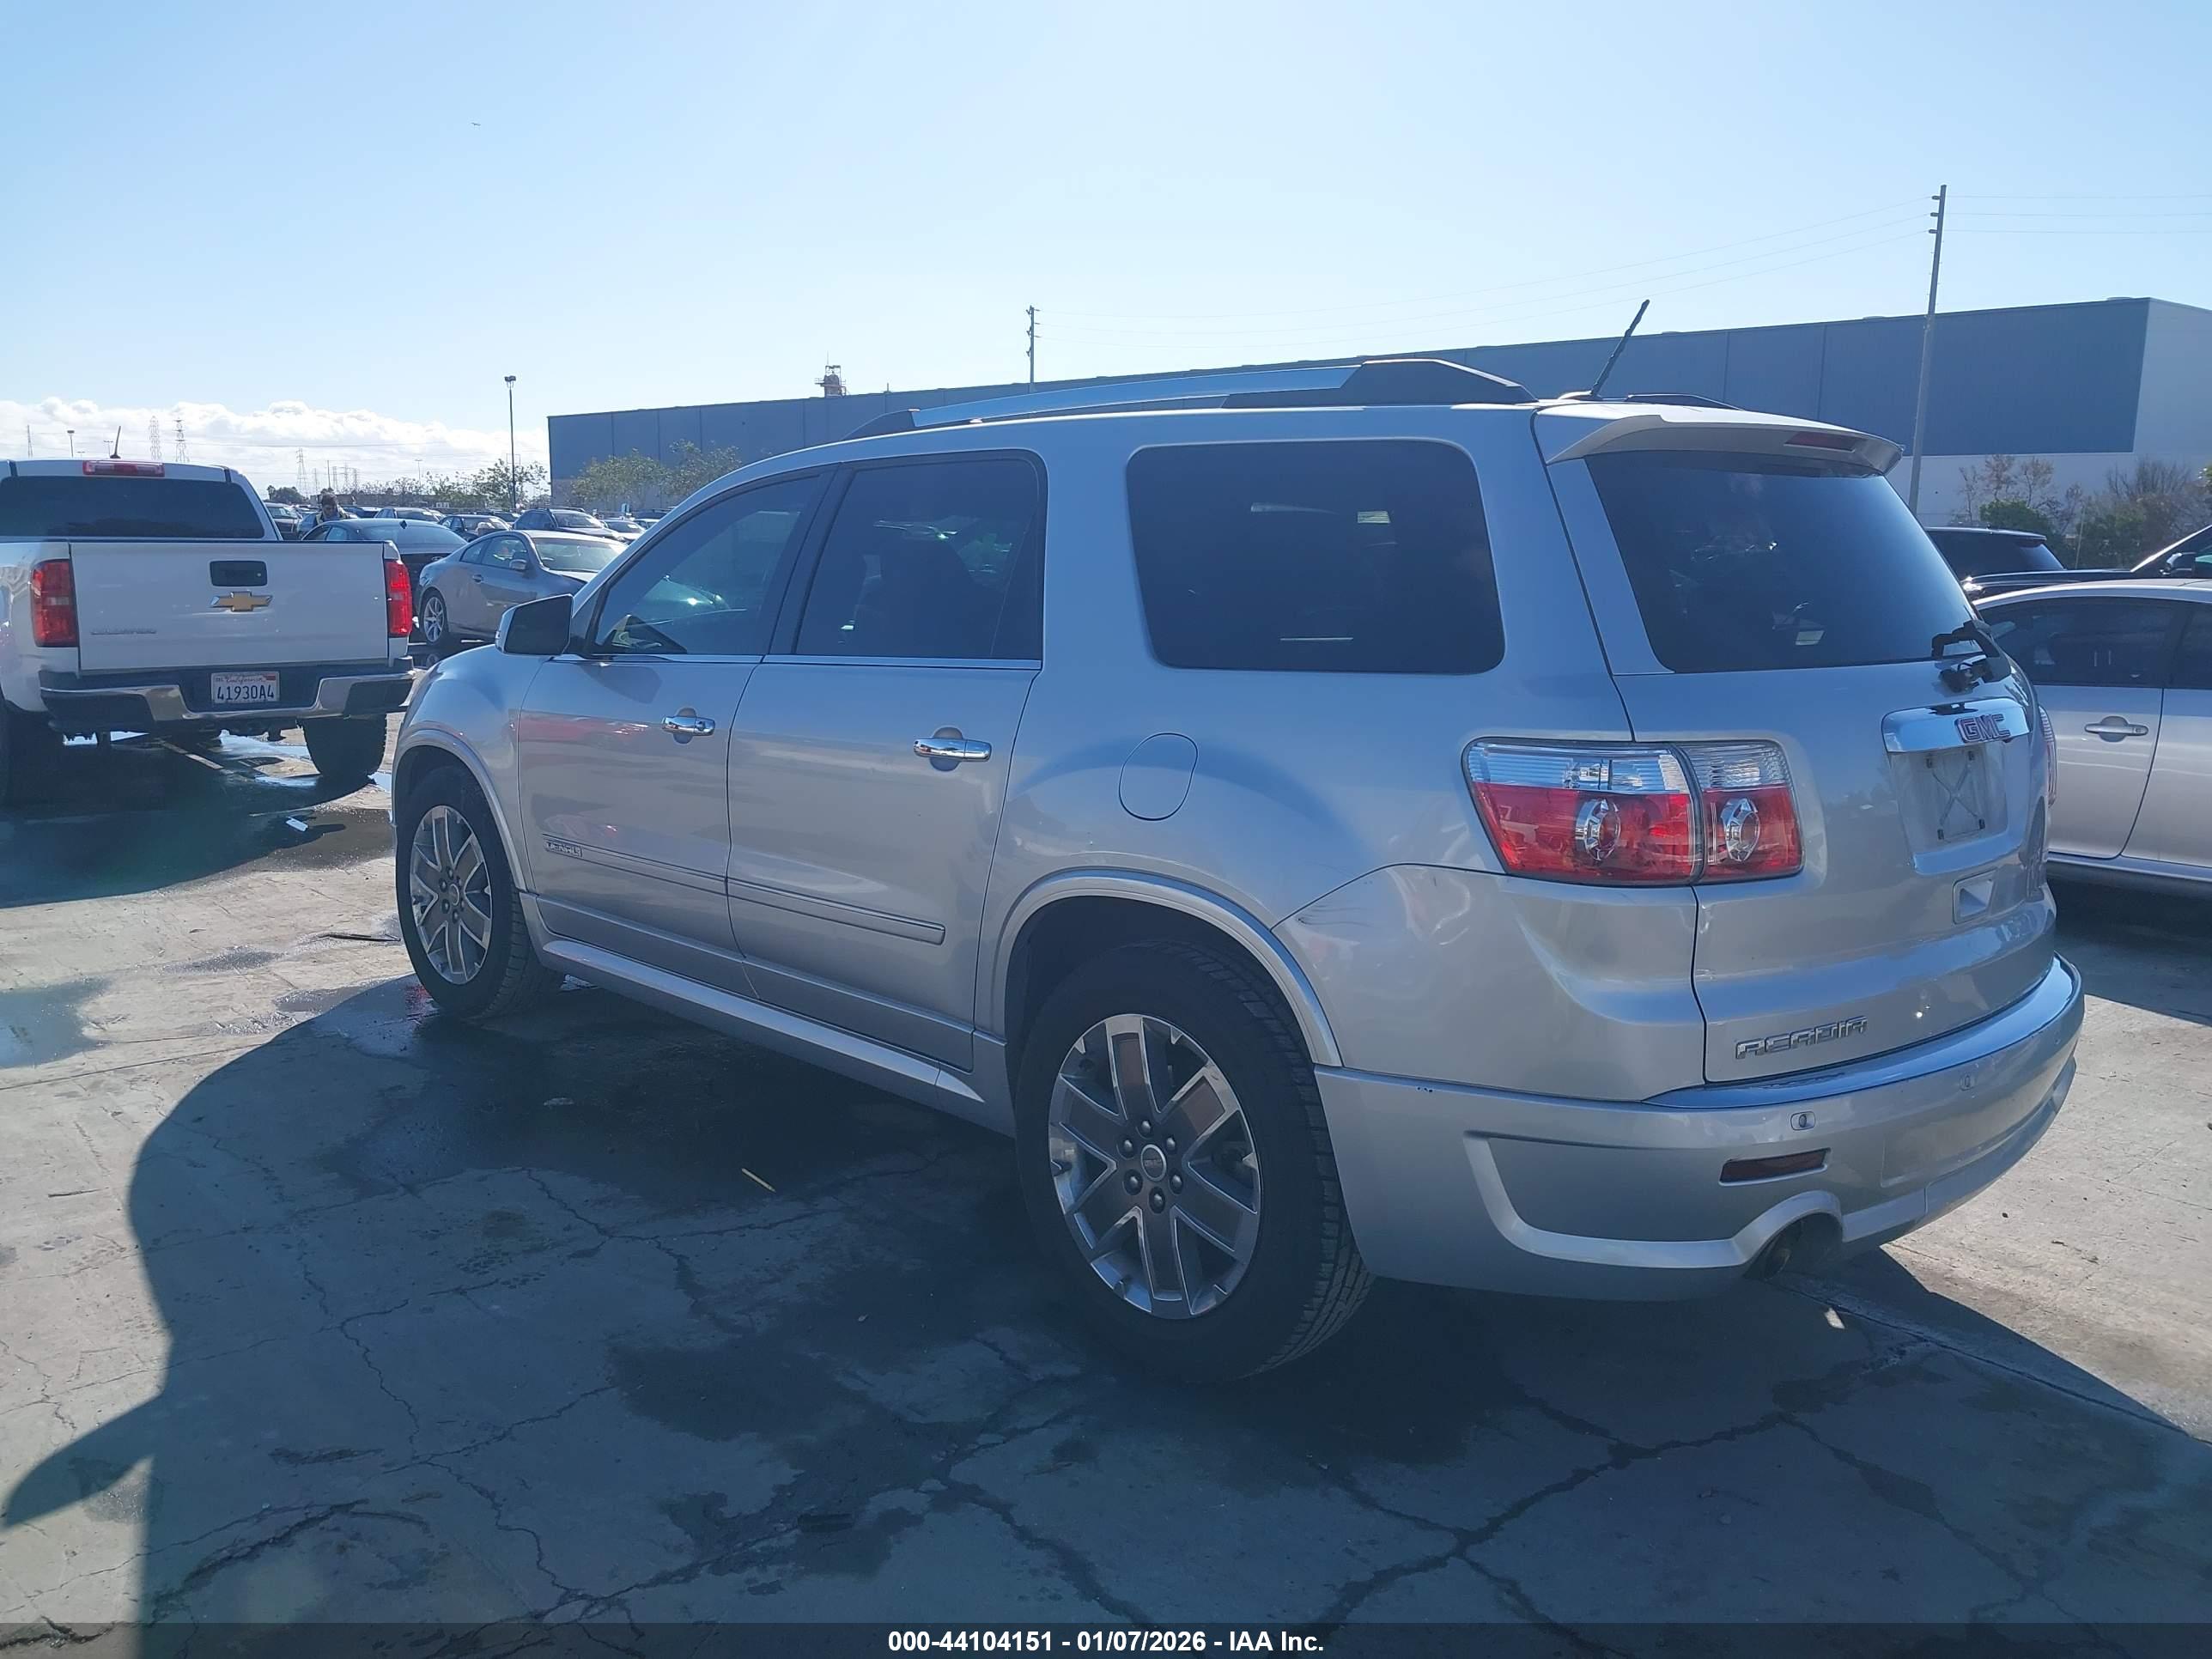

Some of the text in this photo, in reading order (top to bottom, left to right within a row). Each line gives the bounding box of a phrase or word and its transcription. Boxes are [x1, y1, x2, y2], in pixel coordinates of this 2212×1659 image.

[217, 684, 273, 700] 41930A4
[1954, 714, 2010, 744] GMC
[1735, 1016, 1868, 1059] ACADIA
